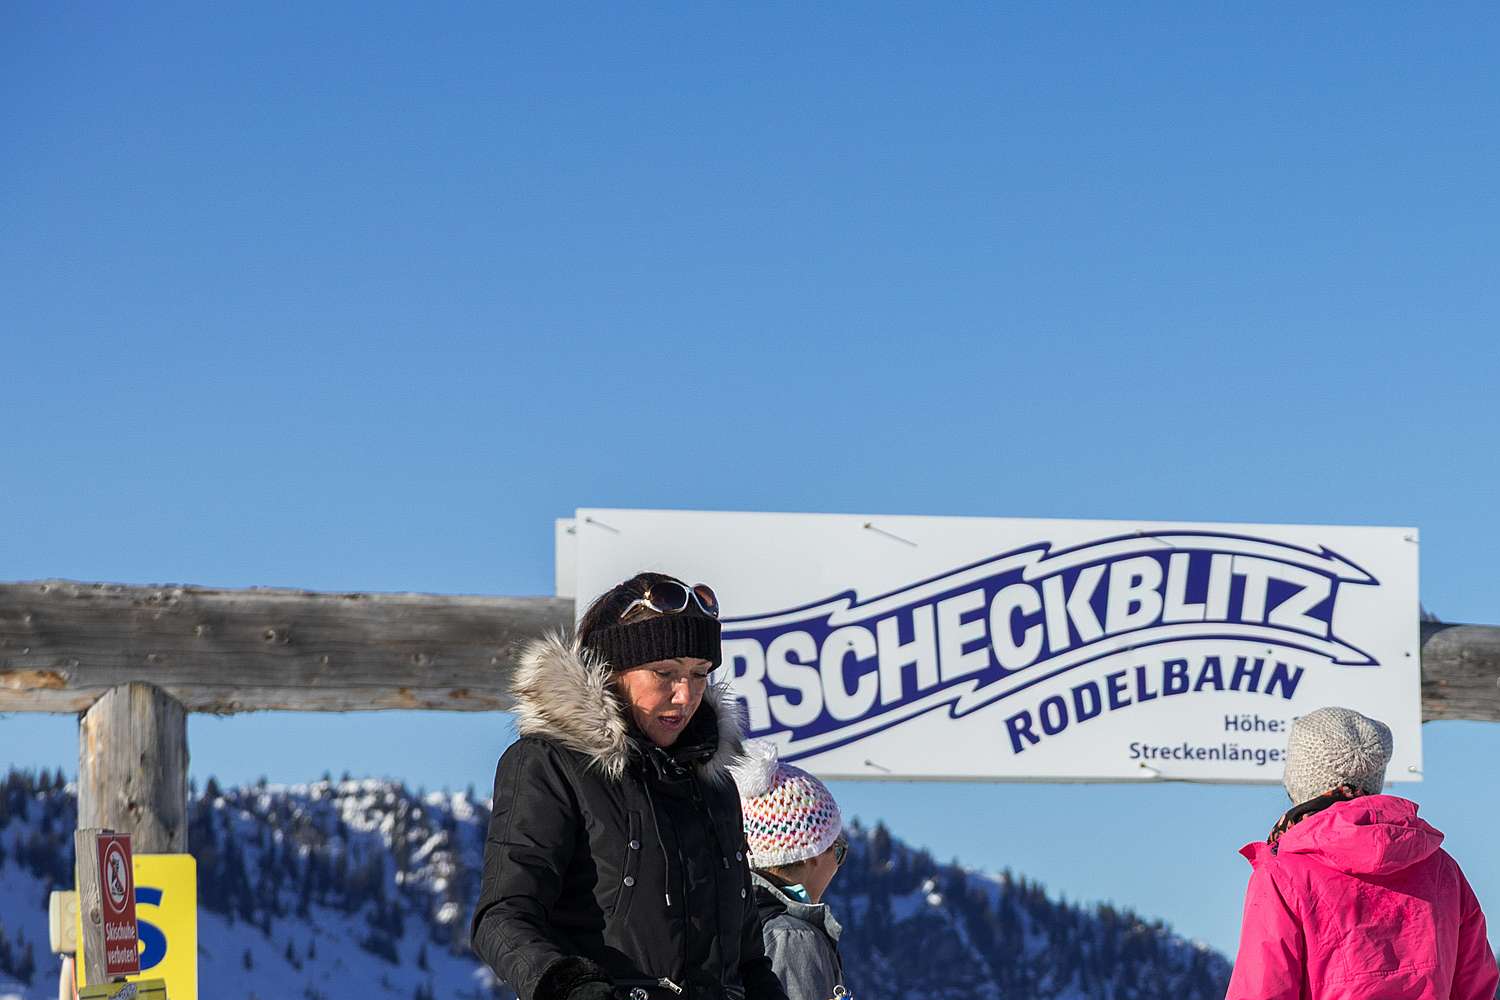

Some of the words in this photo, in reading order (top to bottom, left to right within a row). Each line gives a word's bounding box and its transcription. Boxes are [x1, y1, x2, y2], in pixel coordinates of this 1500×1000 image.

[720, 551, 1332, 731] RSCHECKBLITZ
[1004, 654, 1305, 755] RODELBAHN
[1224, 714, 1286, 732] Höhe:
[1129, 742, 1286, 766] Streckenlänge:
